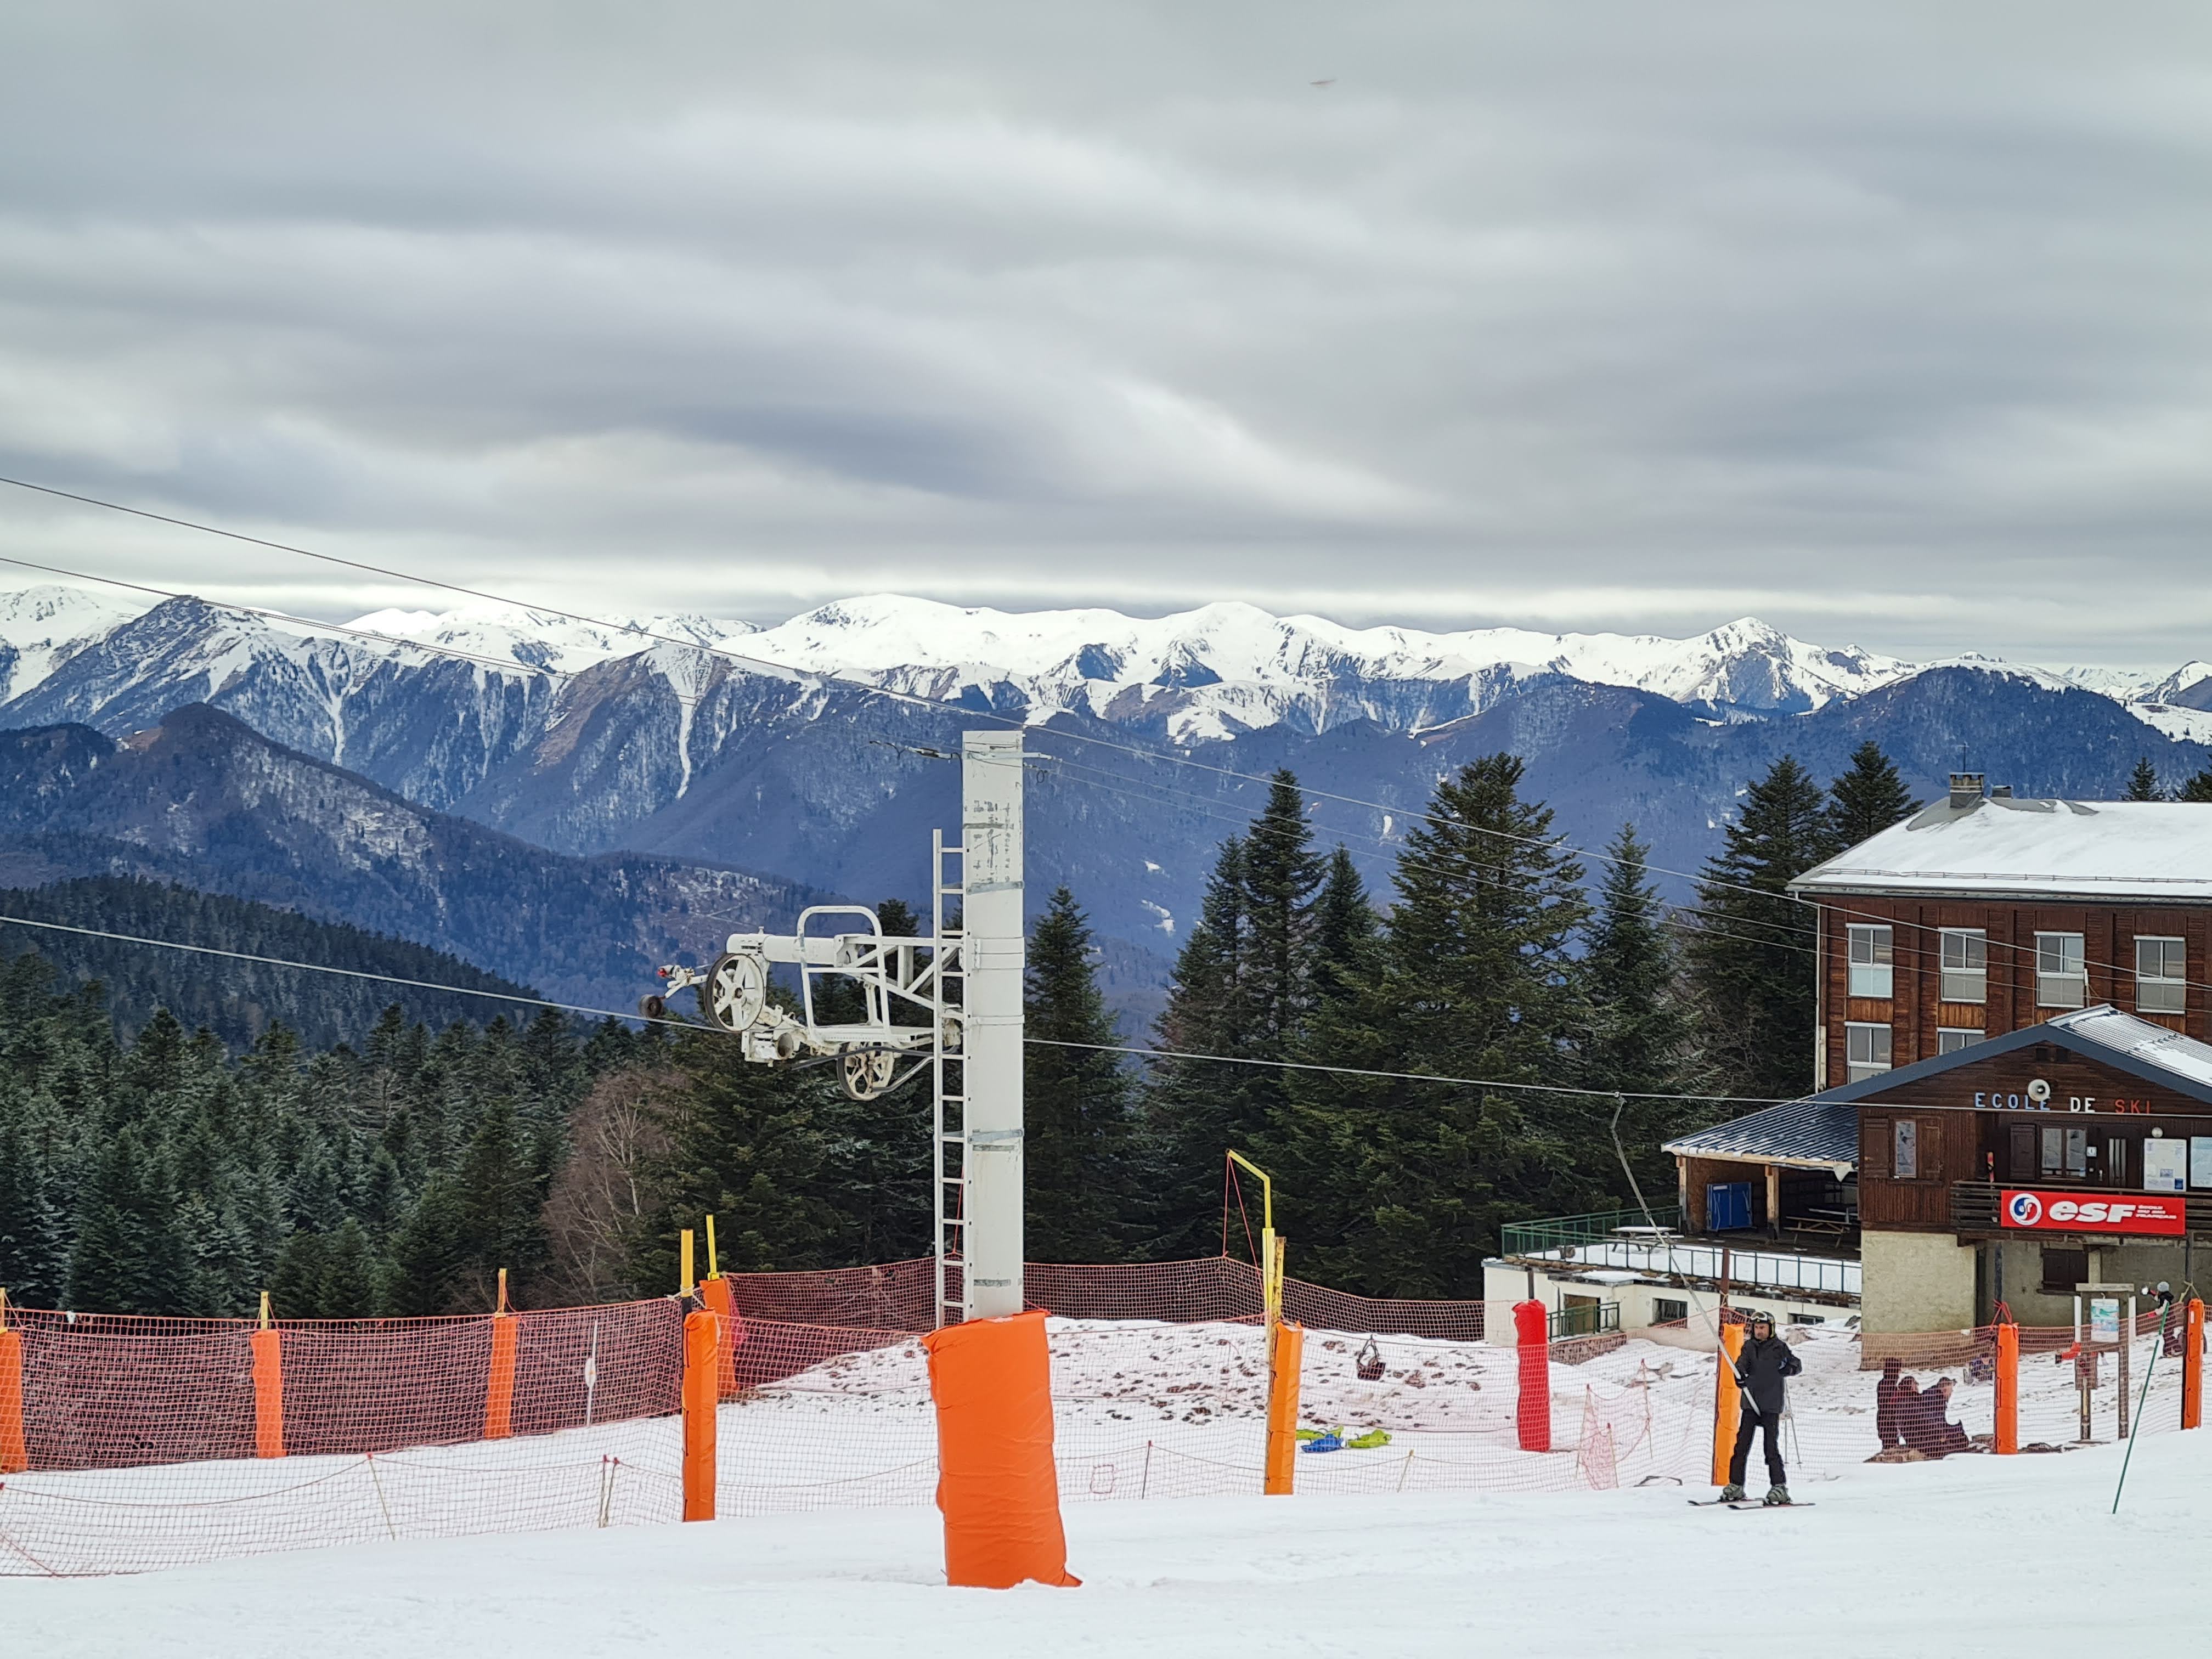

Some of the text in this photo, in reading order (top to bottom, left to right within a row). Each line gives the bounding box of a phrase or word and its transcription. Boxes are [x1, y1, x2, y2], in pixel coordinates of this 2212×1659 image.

[1975, 1092, 2150, 1114] ECOLE DE SKI
